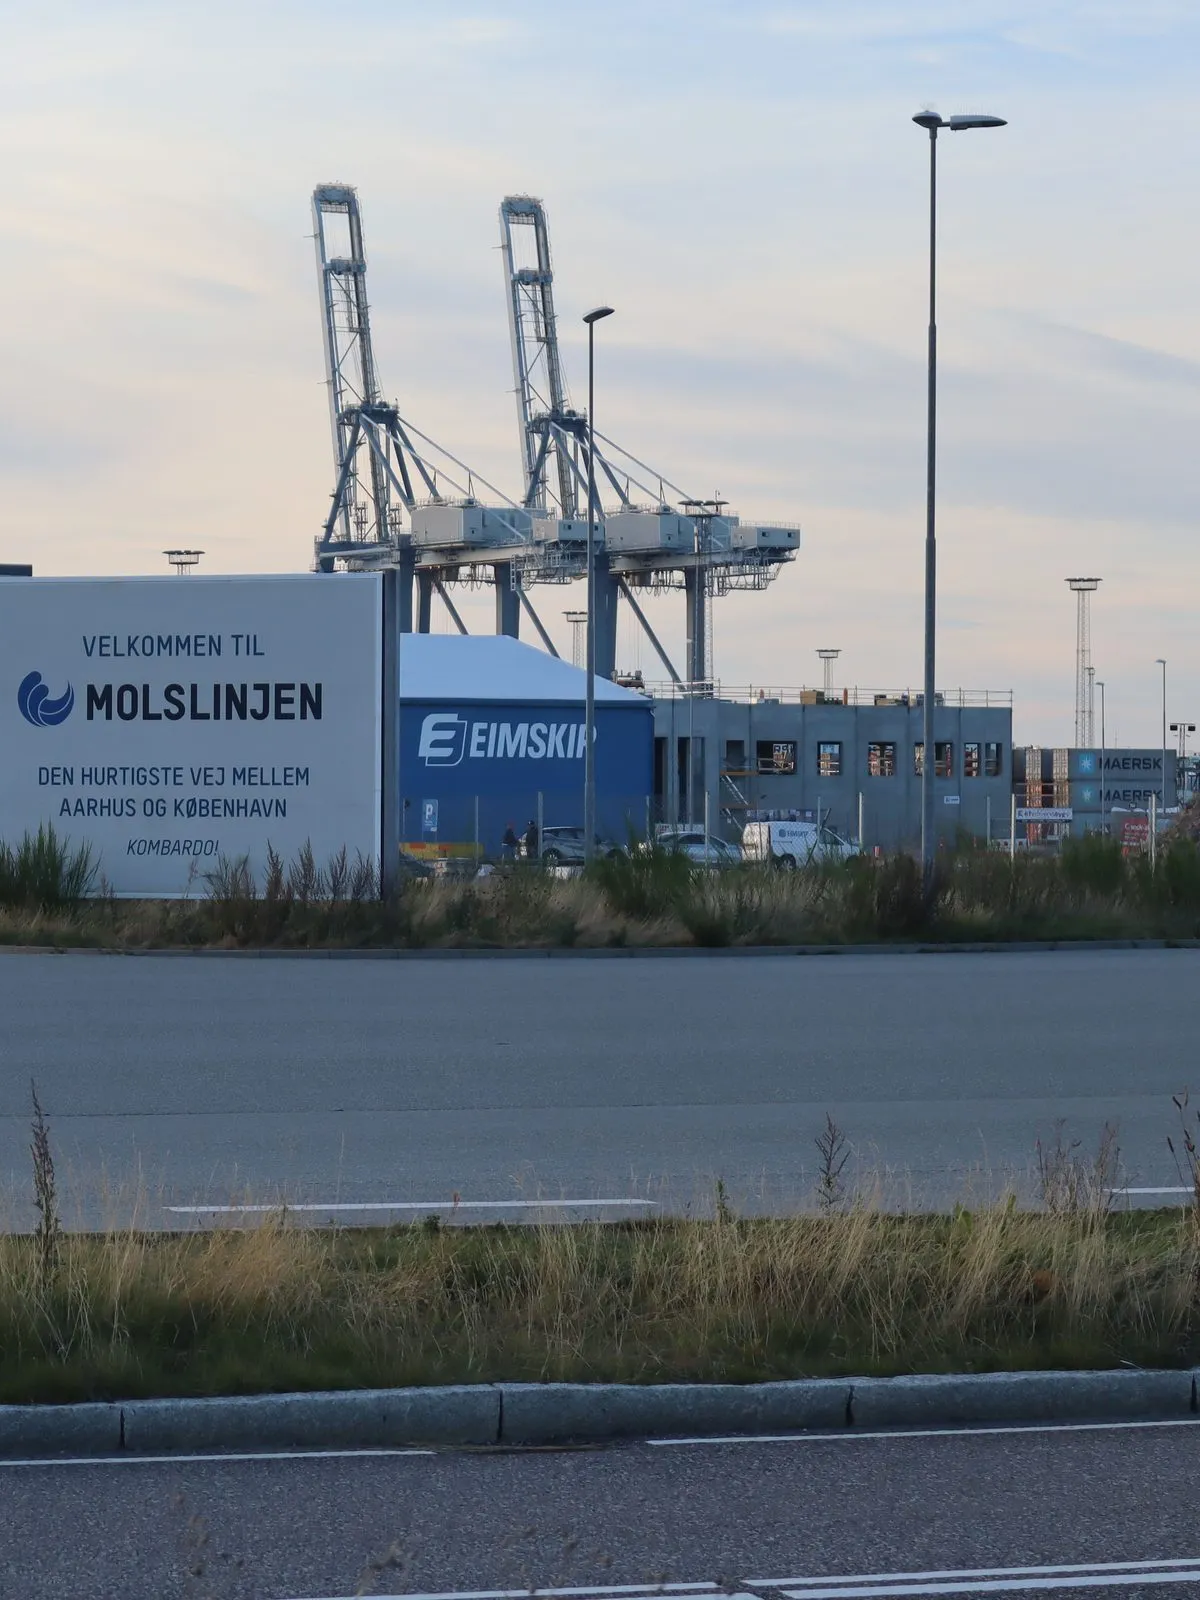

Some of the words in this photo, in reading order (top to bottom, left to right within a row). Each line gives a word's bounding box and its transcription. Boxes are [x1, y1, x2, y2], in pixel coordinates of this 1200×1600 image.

[82, 634, 222, 657] VELKOMMEN
[231, 634, 265, 656] TIL
[86, 682, 323, 721] MOLSLINJEN
[1099, 757, 1163, 770] MAERSK
[38, 767, 74, 786] DEN
[81, 767, 184, 786] HURTIGSTE
[190, 767, 226, 786] VEJ
[232, 767, 310, 786] MELLEM
[1099, 789, 1163, 802] MAERSK
[59, 798, 137, 818] AARHUS
[143, 798, 167, 817] OG
[174, 797, 288, 819] KØBENHAVN
[126, 839, 219, 856] KOMBARDO!
